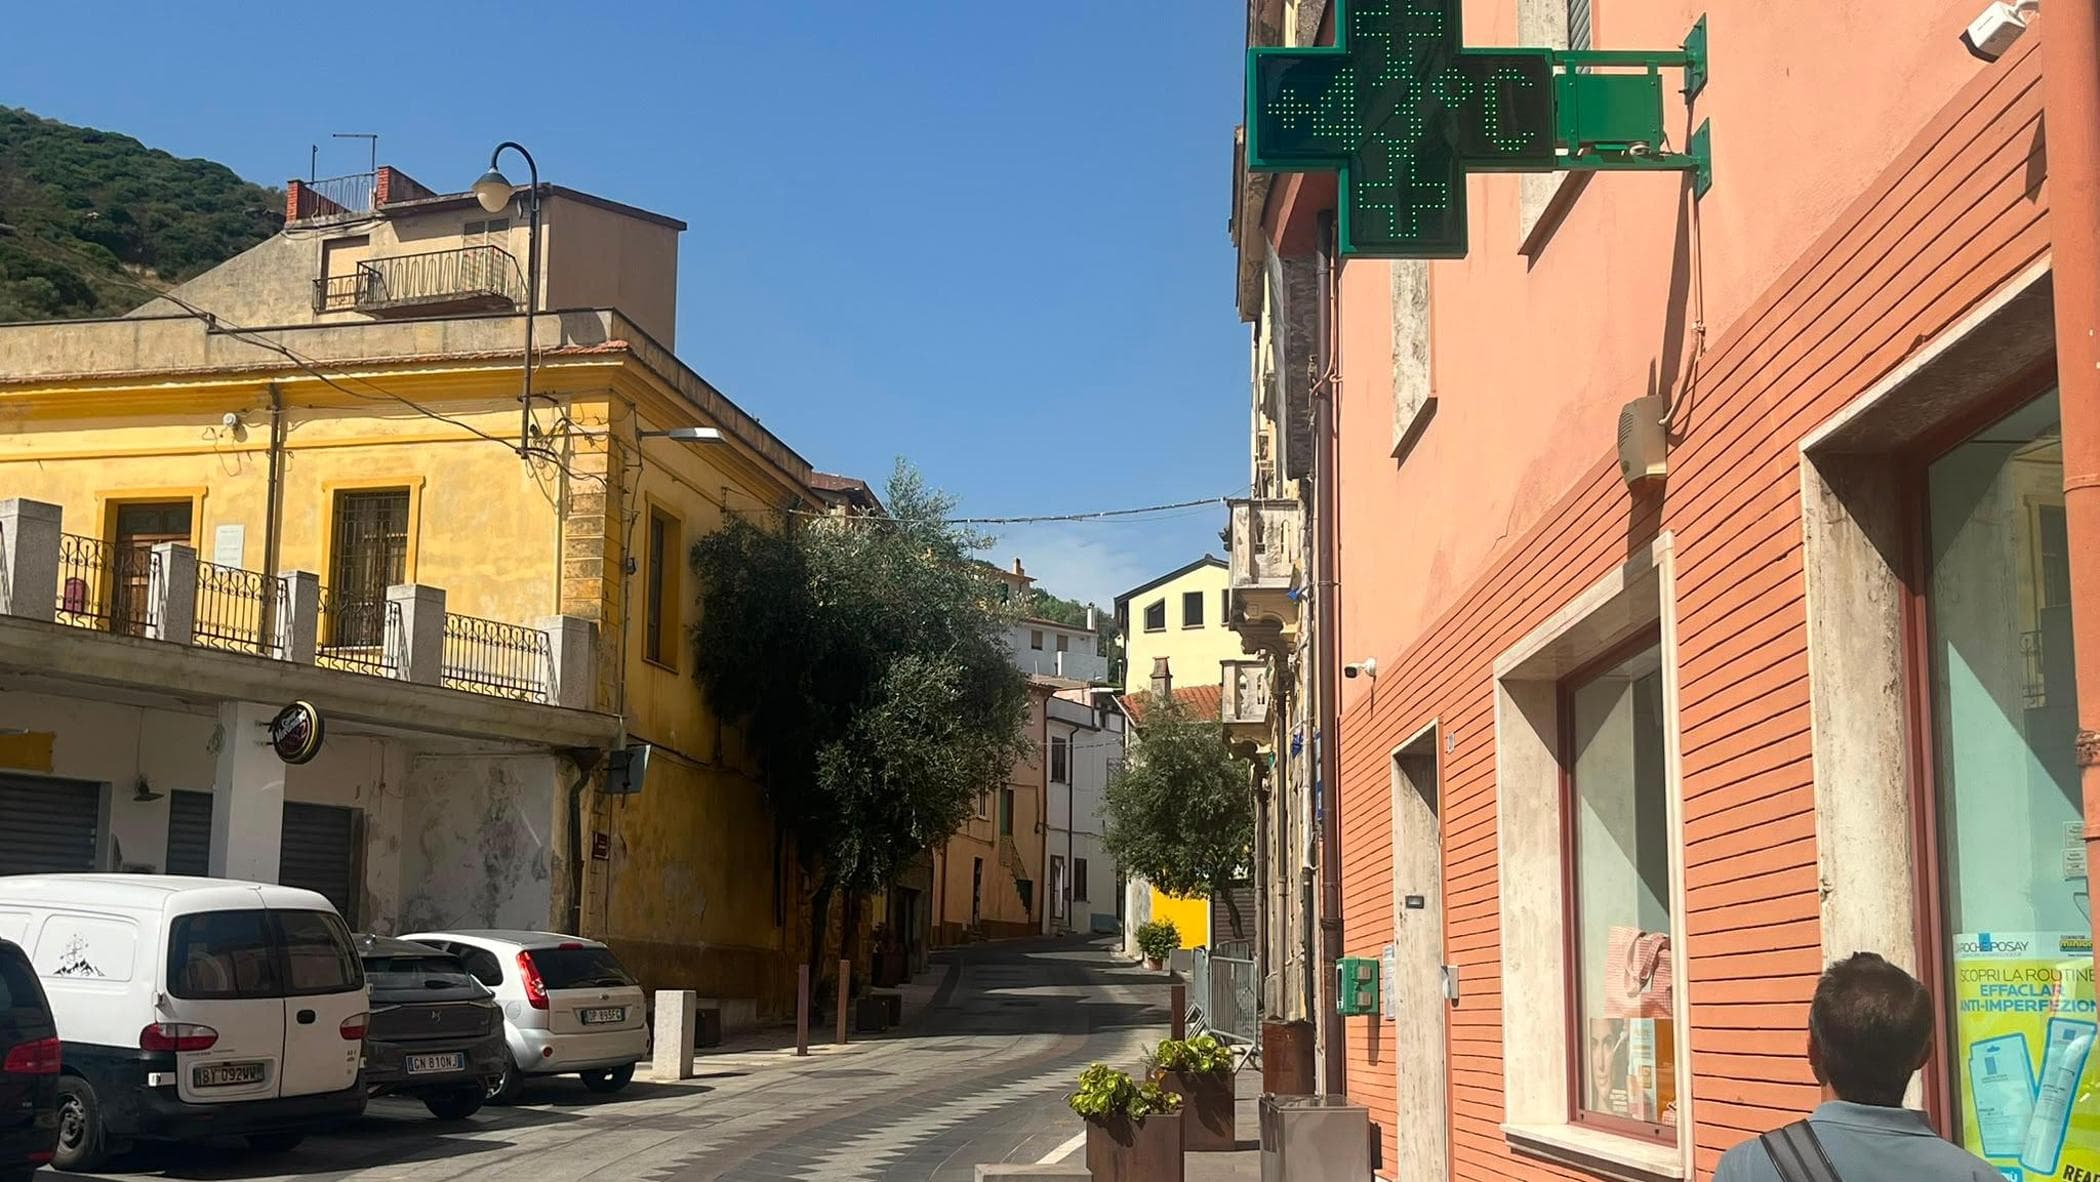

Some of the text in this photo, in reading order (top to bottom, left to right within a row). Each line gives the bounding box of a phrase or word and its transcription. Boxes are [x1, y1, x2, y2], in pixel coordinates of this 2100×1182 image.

[1960, 968, 2000, 983] SCOPRI
[2003, 968, 2022, 982] LA
[1980, 984, 2062, 997] EFFACLAR
